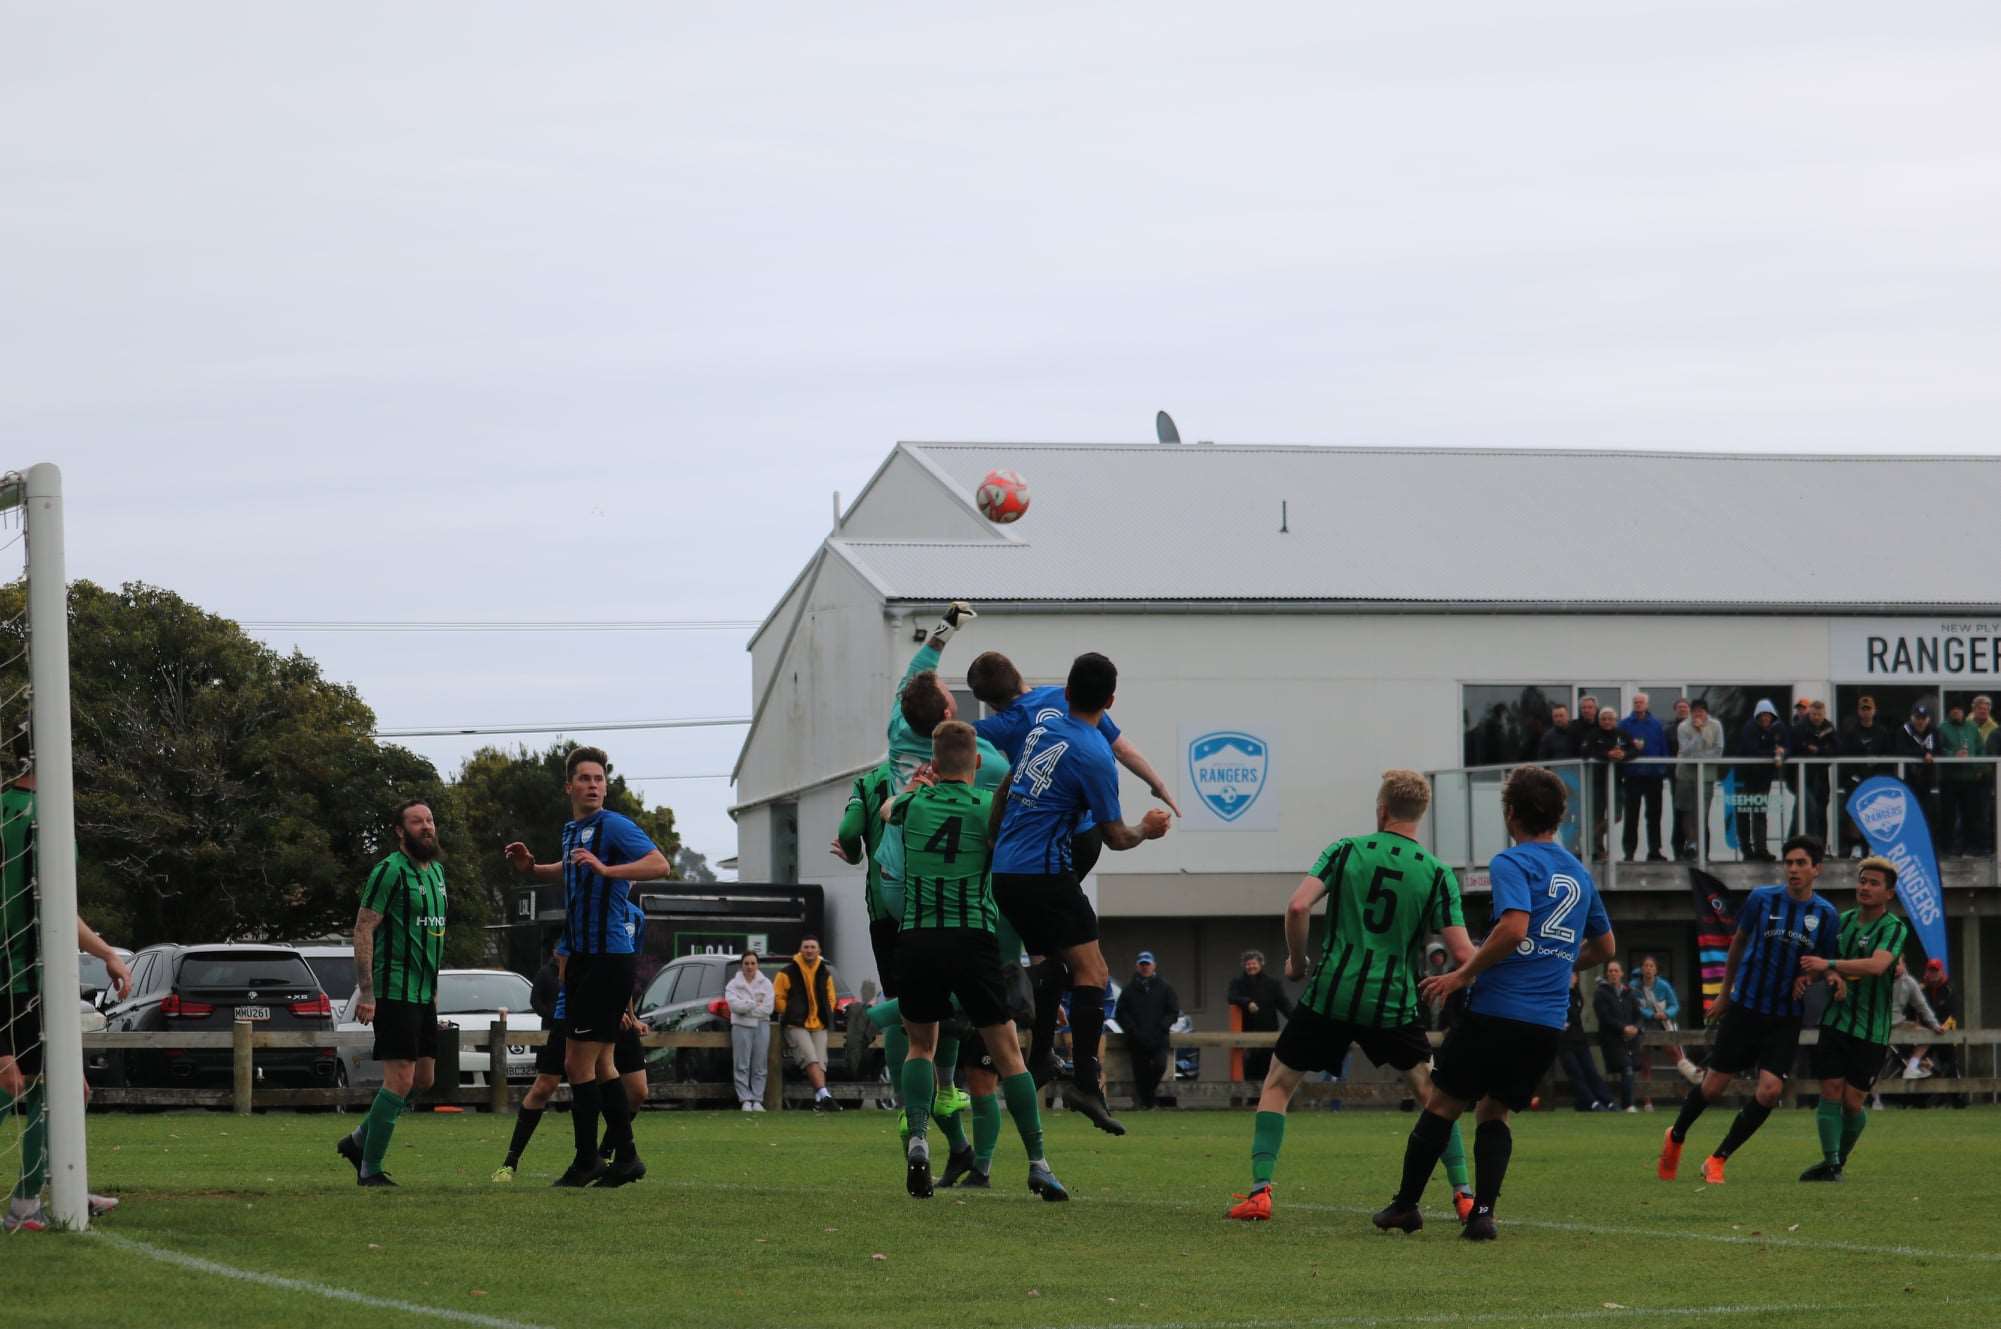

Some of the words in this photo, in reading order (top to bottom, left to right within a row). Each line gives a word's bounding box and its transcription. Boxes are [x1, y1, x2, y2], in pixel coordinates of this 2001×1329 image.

[1941, 624, 1972, 633] NEW
[1014, 726, 1070, 799] 14
[1199, 768, 1257, 784] RANGERS
[923, 815, 963, 864] 4
[1363, 866, 1404, 934] 5
[1541, 873, 1580, 943] 2
[1888, 843, 1941, 926] RANGERS
